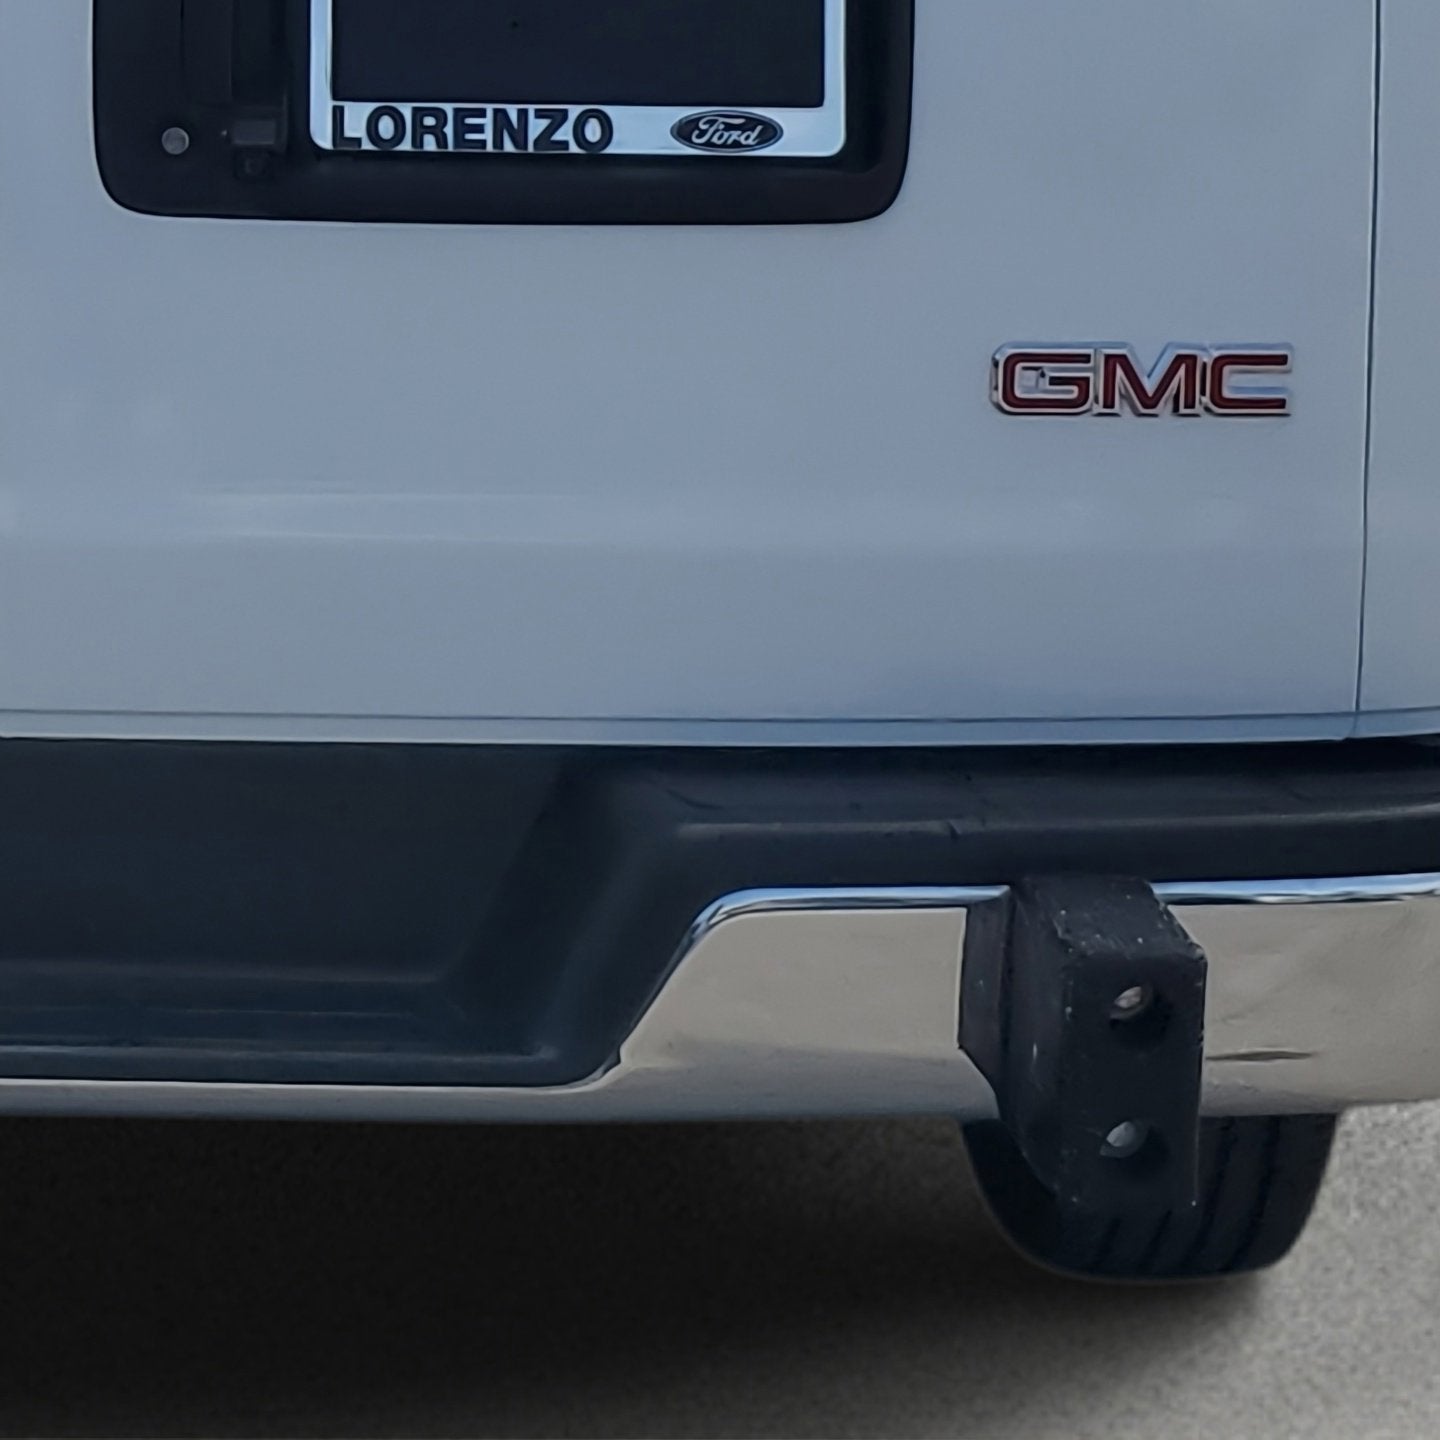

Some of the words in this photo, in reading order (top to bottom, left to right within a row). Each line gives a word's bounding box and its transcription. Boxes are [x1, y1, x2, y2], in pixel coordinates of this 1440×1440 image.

[331, 104, 614, 153] LORENZO
[690, 115, 763, 148] Ford
[989, 341, 1294, 418] GMC
